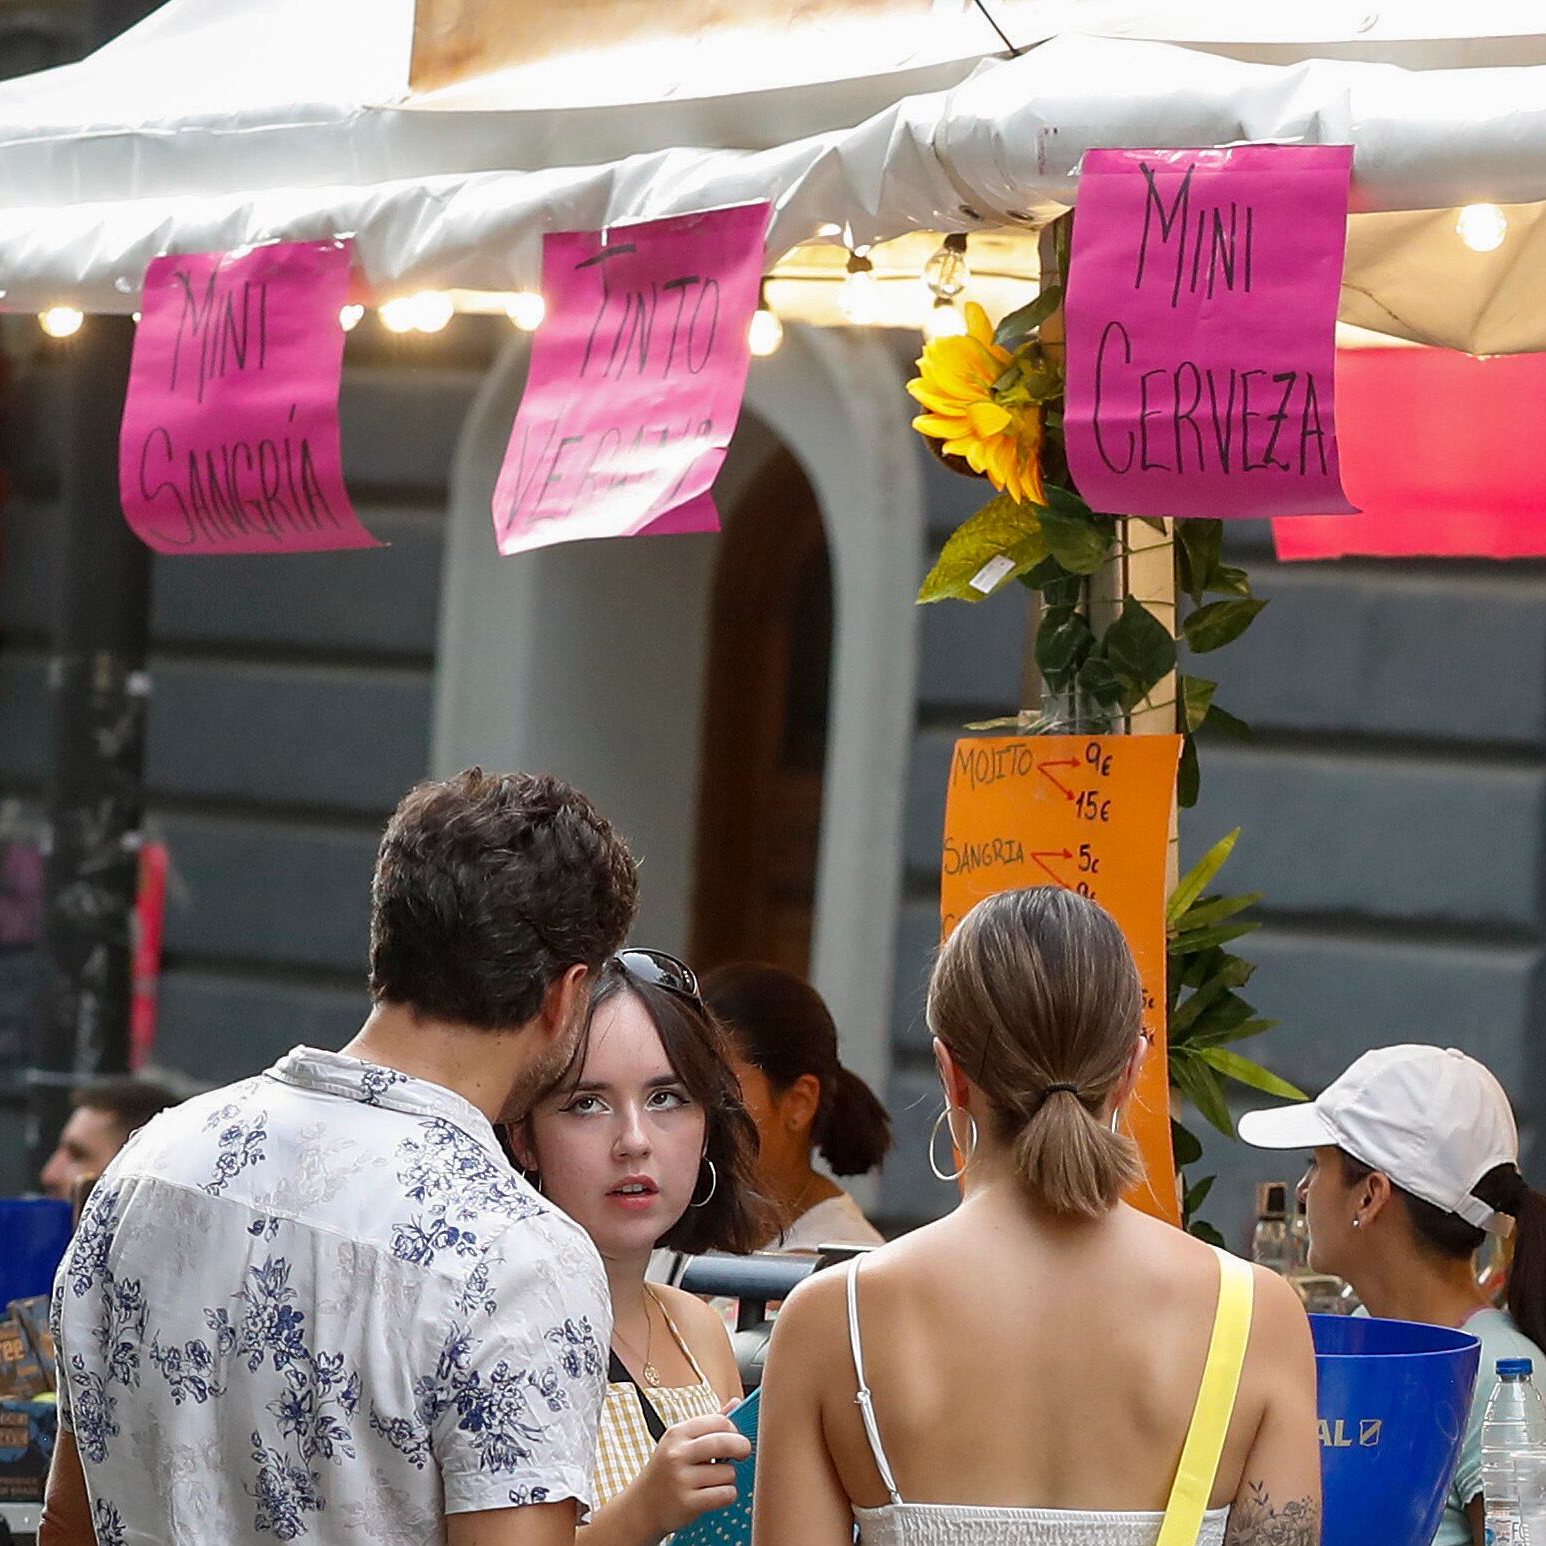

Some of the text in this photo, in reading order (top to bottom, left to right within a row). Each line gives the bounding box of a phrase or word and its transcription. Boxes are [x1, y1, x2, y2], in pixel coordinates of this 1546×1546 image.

[1136, 162, 1256, 308] MINI
[169, 268, 268, 404] MINI
[575, 243, 721, 381] TINTO
[1093, 321, 1329, 479] CERVEZA
[954, 743, 1034, 790] MOJITO
[944, 837, 1024, 875] SANGRIA
